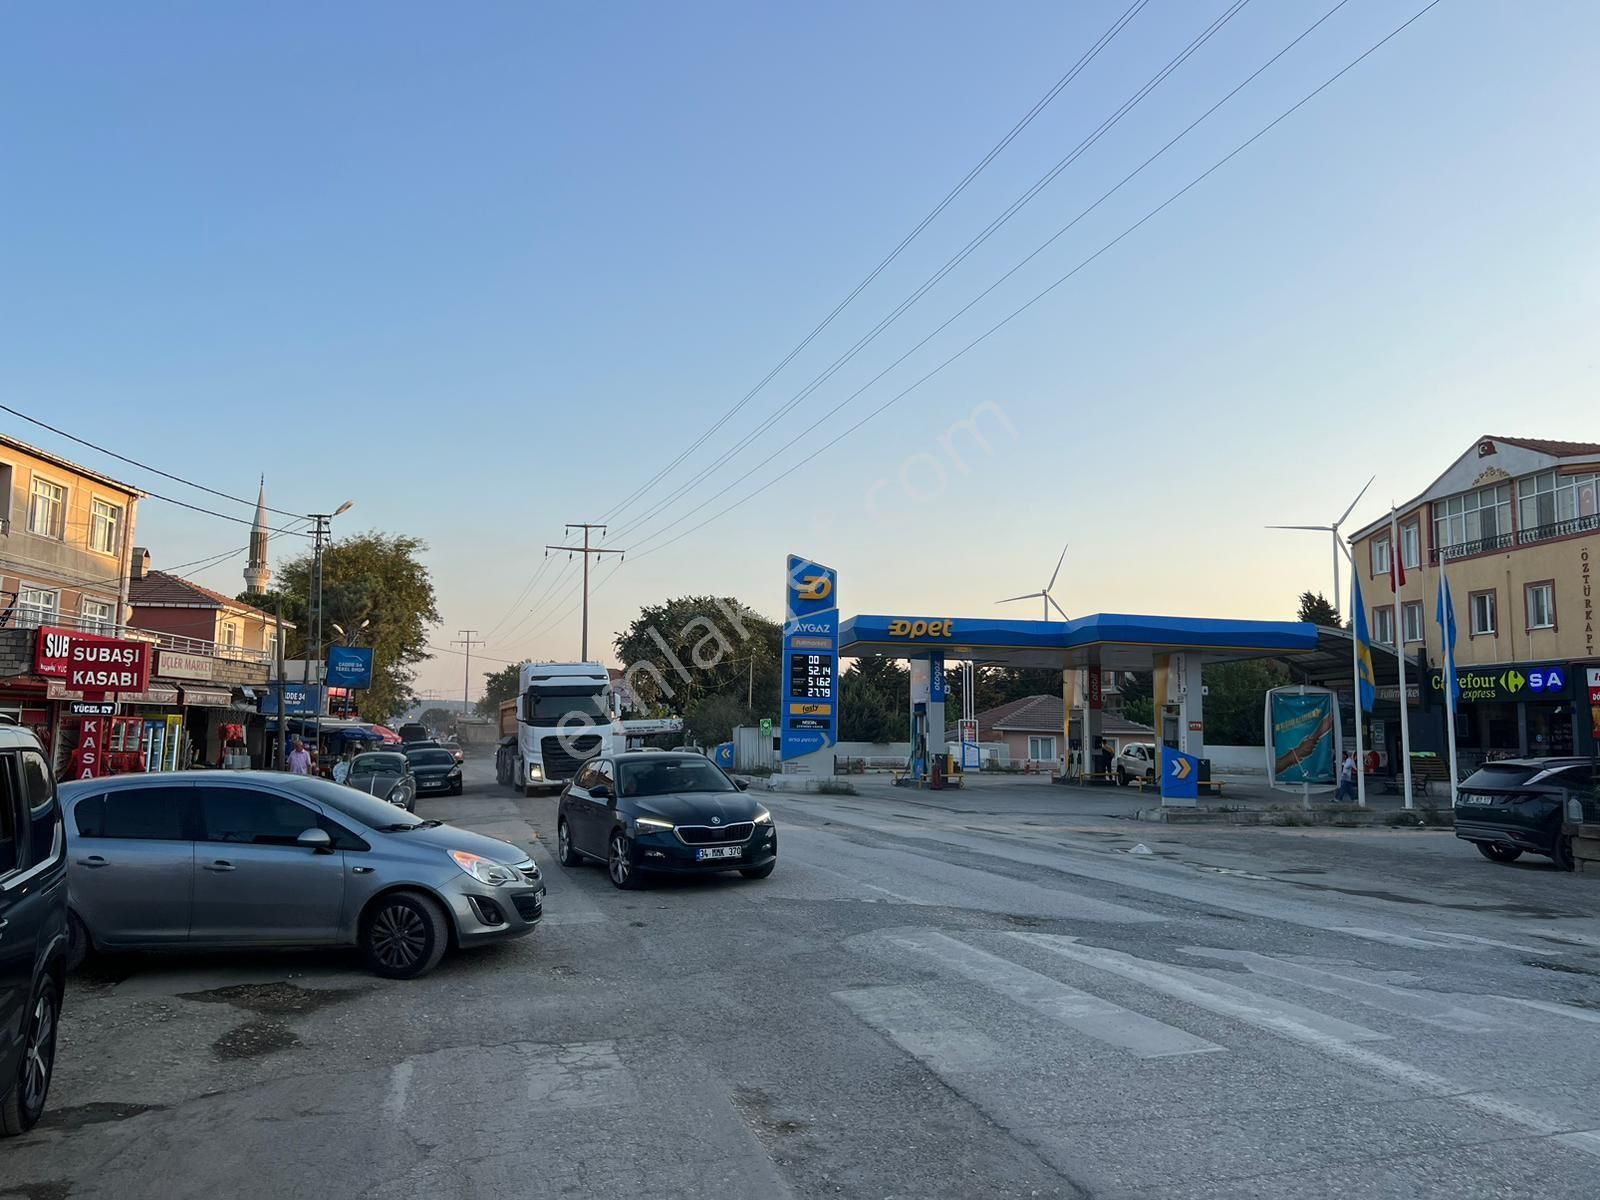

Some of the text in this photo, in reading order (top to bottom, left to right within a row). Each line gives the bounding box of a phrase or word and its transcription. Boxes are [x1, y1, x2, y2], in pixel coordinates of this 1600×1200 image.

[794, 624, 830, 633] AYGAZ
[888, 620, 953, 638] opet
[73, 647, 139, 667] SUBAŞI
[184, 657, 212, 673] MARKET
[808, 666, 830, 675] 52.14
[73, 670, 138, 687] KASABI
[1432, 672, 1496, 690] Cefour
[1463, 689, 1496, 702] express
[74, 703, 99, 714] YÜCEL
[729, 846, 741, 856] 370
